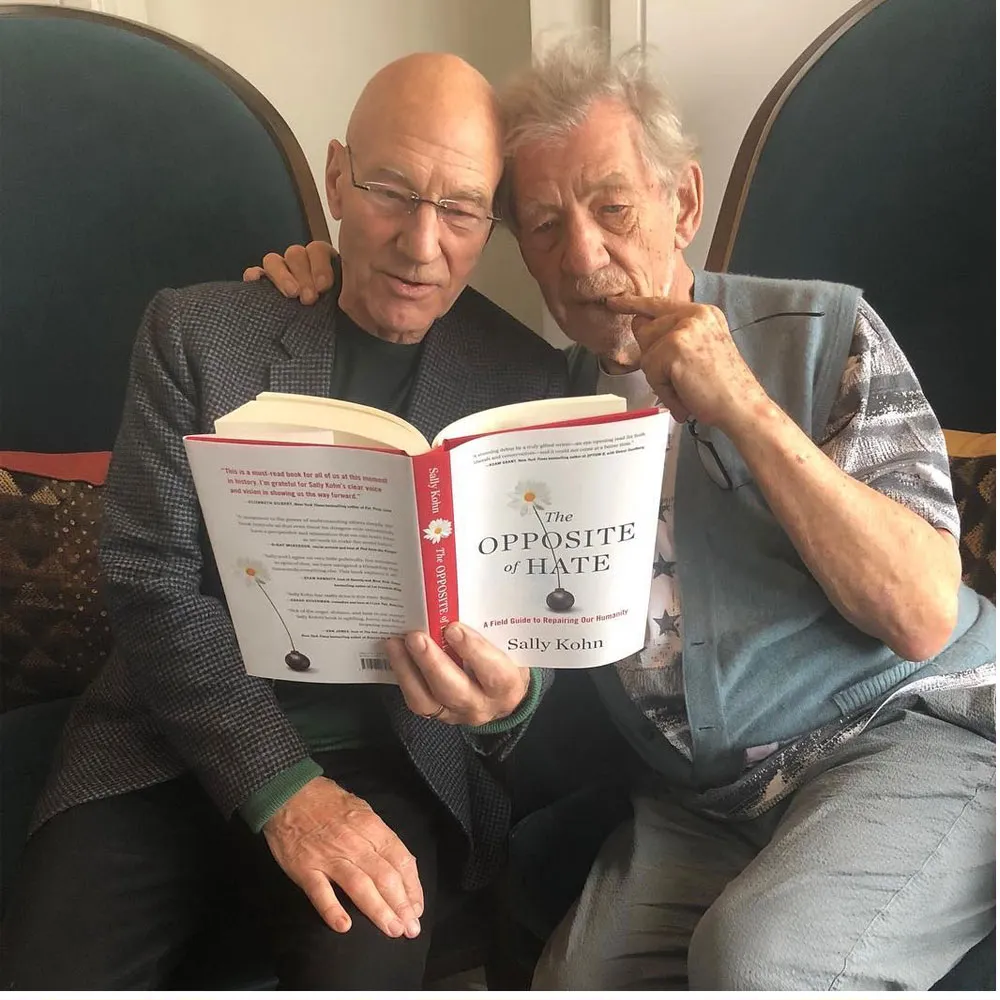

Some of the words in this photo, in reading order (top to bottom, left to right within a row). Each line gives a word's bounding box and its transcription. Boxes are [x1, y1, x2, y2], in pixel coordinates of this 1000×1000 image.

[271, 480, 297, 488] grateful
[308, 481, 324, 489] Sally
[347, 483, 363, 491] clear
[428, 467, 440, 489] Sally
[430, 490, 442, 514] Kohn
[545, 511, 574, 523] The
[478, 521, 636, 555] OPPOSITE
[435, 548, 446, 563] The
[503, 560, 521, 575] of
[526, 553, 610, 575] HATE
[435, 565, 449, 615] OPPOSITE
[483, 621, 489, 629] A
[490, 618, 508, 628] Field
[510, 616, 531, 625] Guide
[533, 617, 541, 625] to
[543, 616, 579, 625] Repairing
[580, 616, 594, 624] Our
[596, 608, 629, 622] Humanity
[507, 637, 551, 653] Sally
[555, 638, 604, 651] Kohn
